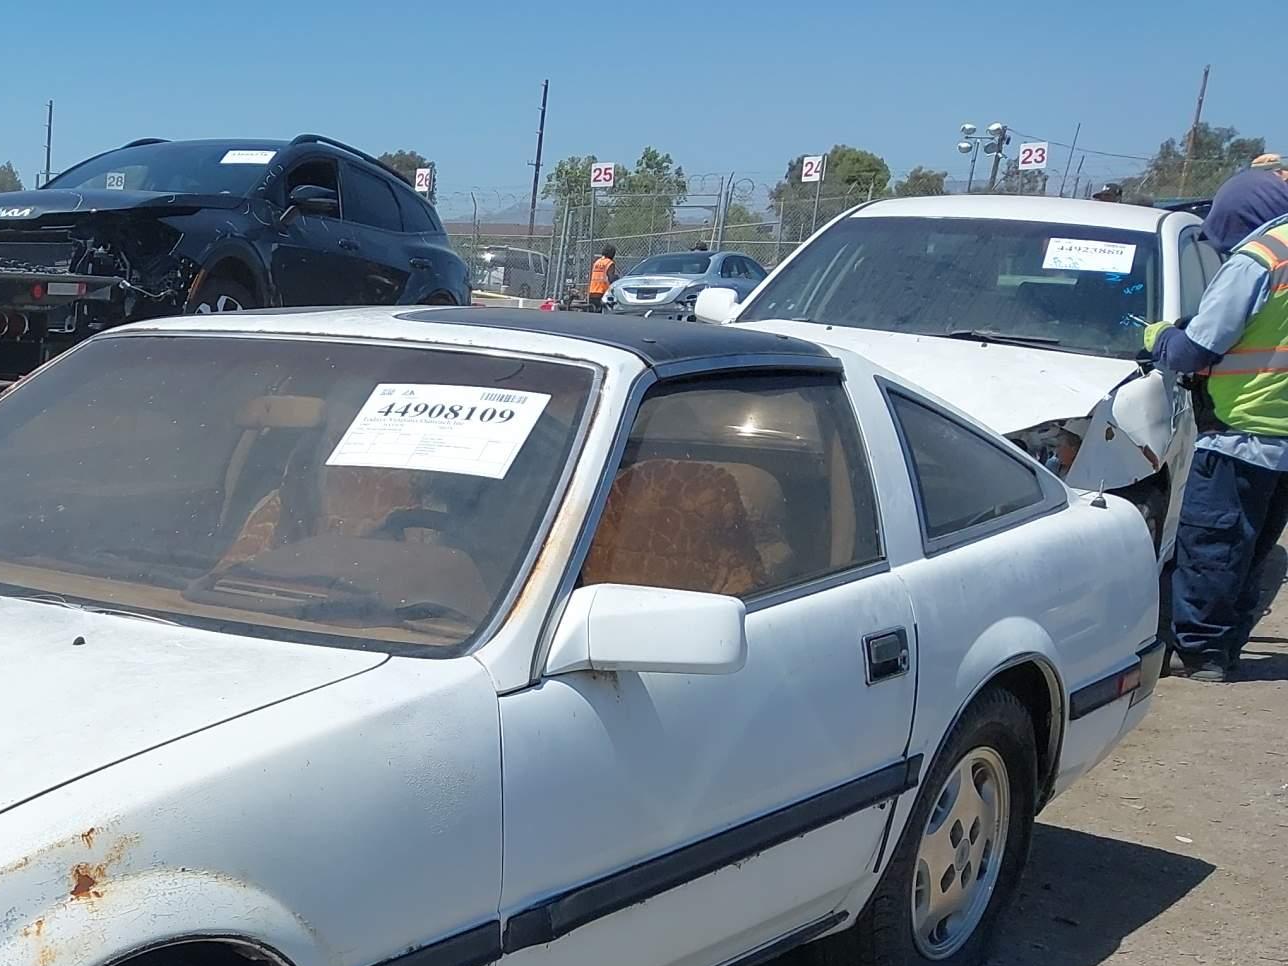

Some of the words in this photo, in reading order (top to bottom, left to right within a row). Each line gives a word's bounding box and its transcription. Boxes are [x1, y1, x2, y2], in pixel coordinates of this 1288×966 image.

[1021, 147, 1045, 164] 23
[107, 175, 123, 187] 28
[593, 167, 613, 182] 25
[377, 402, 515, 424] 44908109
